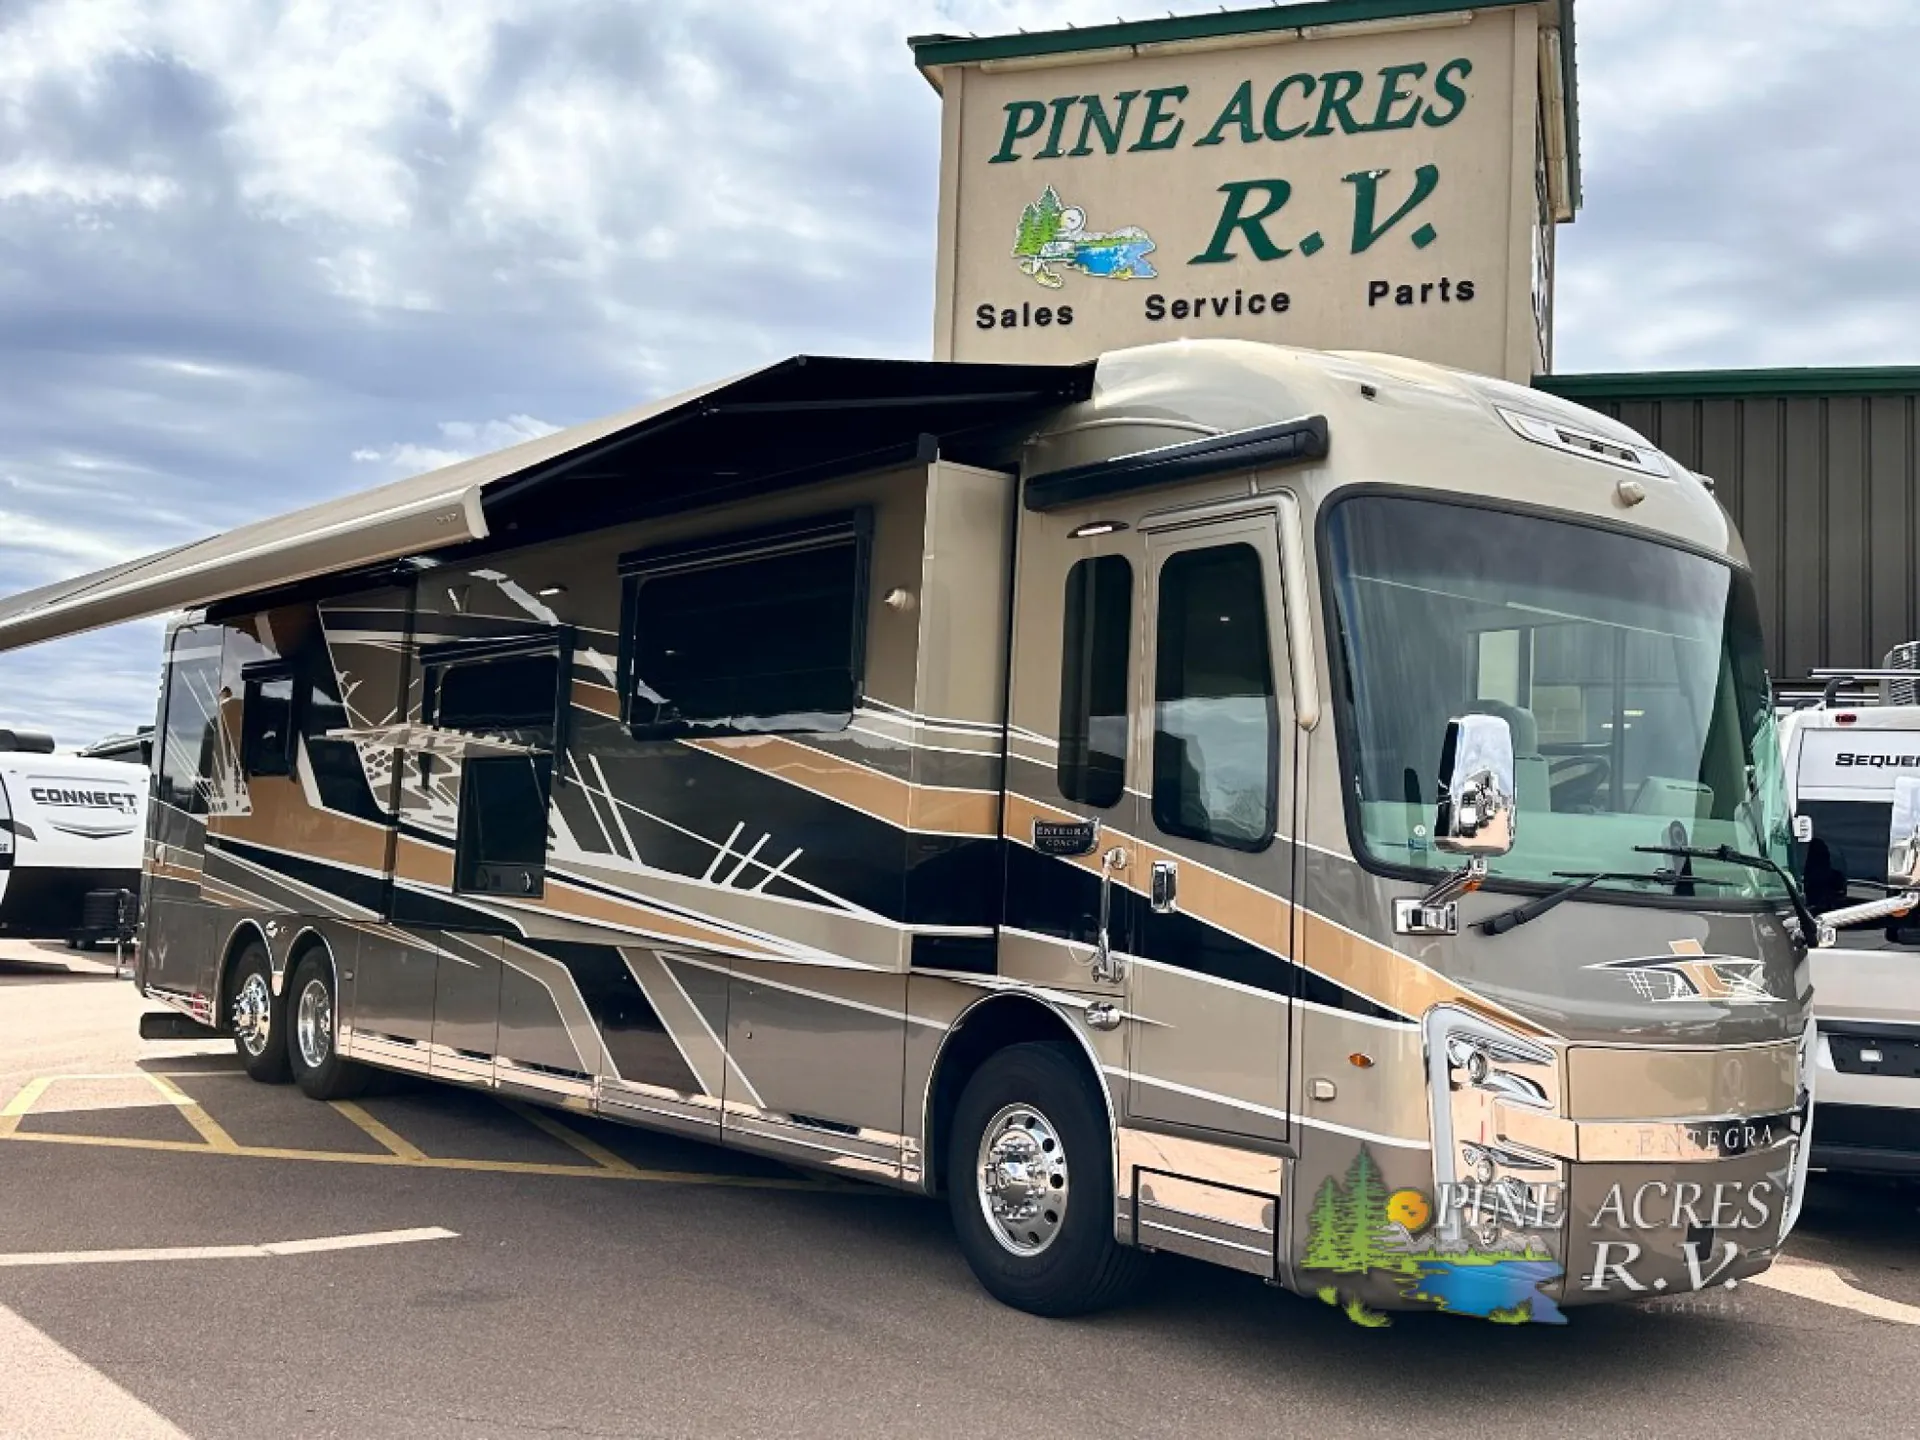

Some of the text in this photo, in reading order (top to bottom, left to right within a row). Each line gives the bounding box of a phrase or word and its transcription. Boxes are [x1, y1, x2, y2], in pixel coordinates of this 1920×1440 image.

[989, 57, 1473, 164] PINE ACRES
[1187, 164, 1439, 266] R.V.
[976, 277, 1475, 330] Sales Service Parts
[1835, 753, 1920, 767] SEQUE
[30, 788, 138, 807] CONNECT
[1045, 839, 1079, 847] COACH
[1637, 1124, 1774, 1157] ENTEGRA
